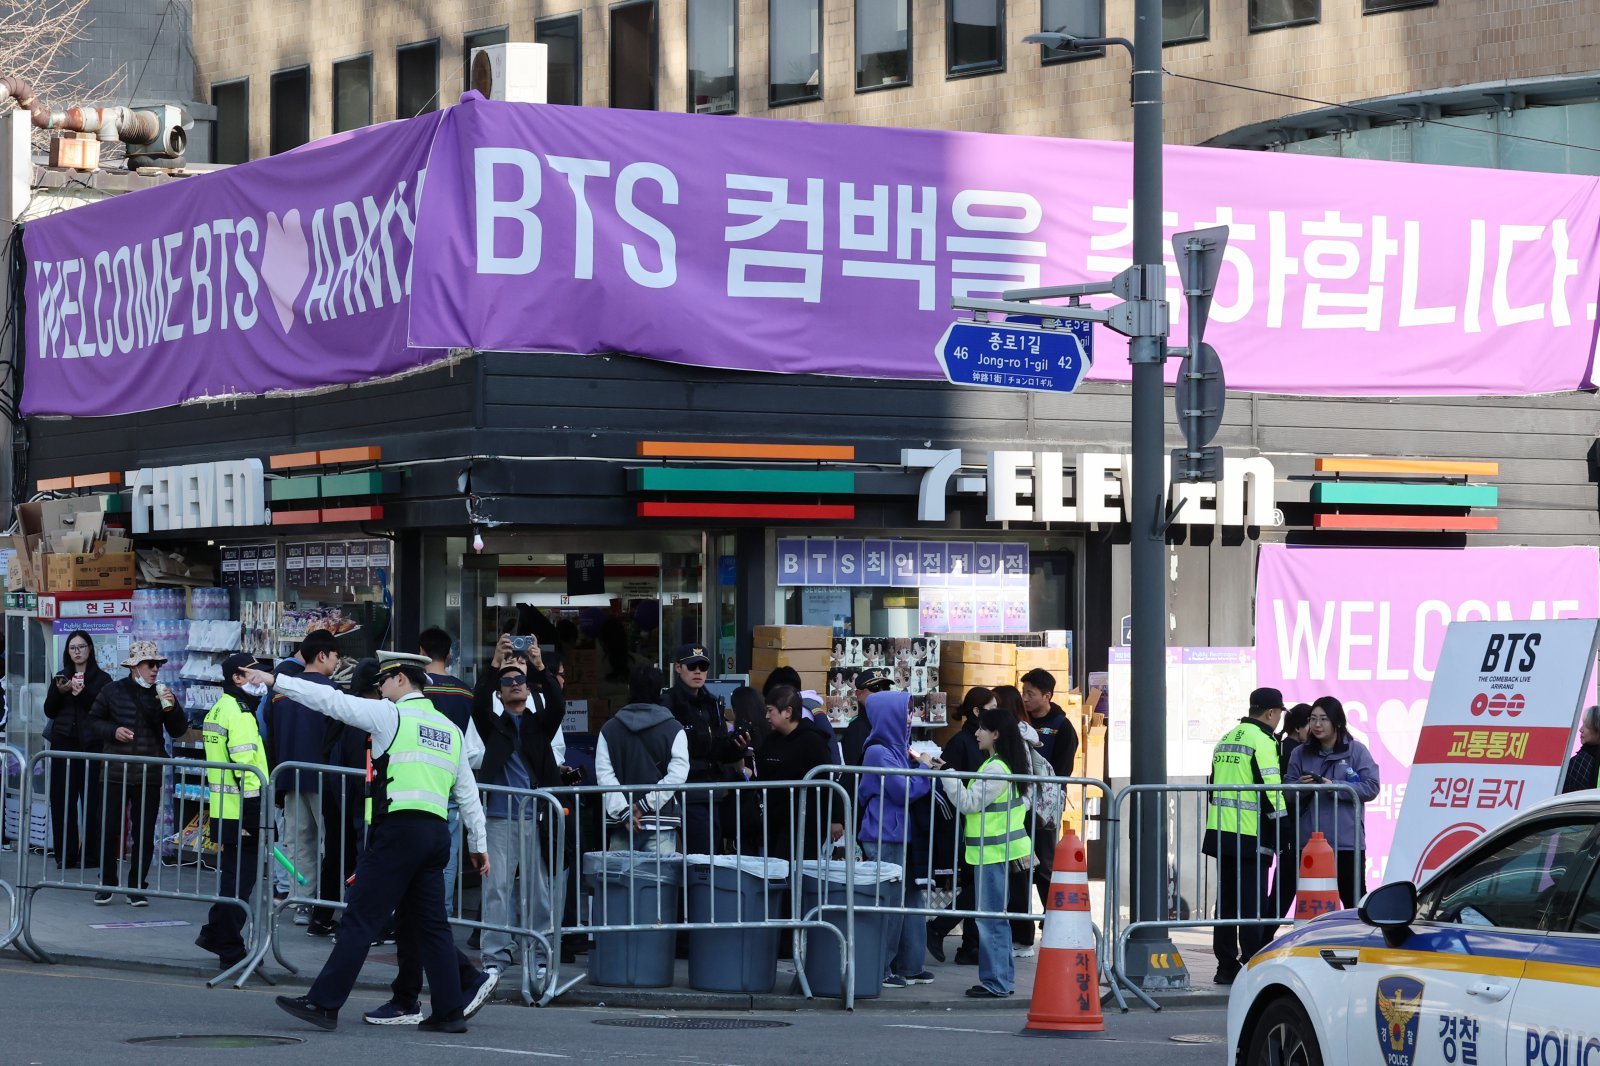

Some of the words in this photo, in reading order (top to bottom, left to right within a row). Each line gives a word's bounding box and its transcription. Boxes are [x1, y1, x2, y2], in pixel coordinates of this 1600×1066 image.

[474, 146, 679, 288] BTS
[724, 172, 1047, 310] 컴백을
[34, 231, 185, 359] WELCOME
[190, 216, 260, 335] BTS
[304, 168, 426, 324] ARMY
[953, 346, 969, 360] 46
[988, 332, 1041, 354] 종로1길
[977, 353, 1021, 369] Jong-ro
[1024, 358, 1048, 371] 1-gil
[1057, 356, 1072, 369] 42
[1273, 599, 1580, 682] WELC
[1480, 632, 1542, 673] BTS
[422, 738, 449, 751] POLICE
[1447, 731, 1529, 760] 교통통제
[1429, 777, 1474, 808] 진입
[1476, 777, 1526, 811] 금지
[1439, 1014, 1480, 1066] 경찰
[1388, 1053, 1409, 1066] POLICE
